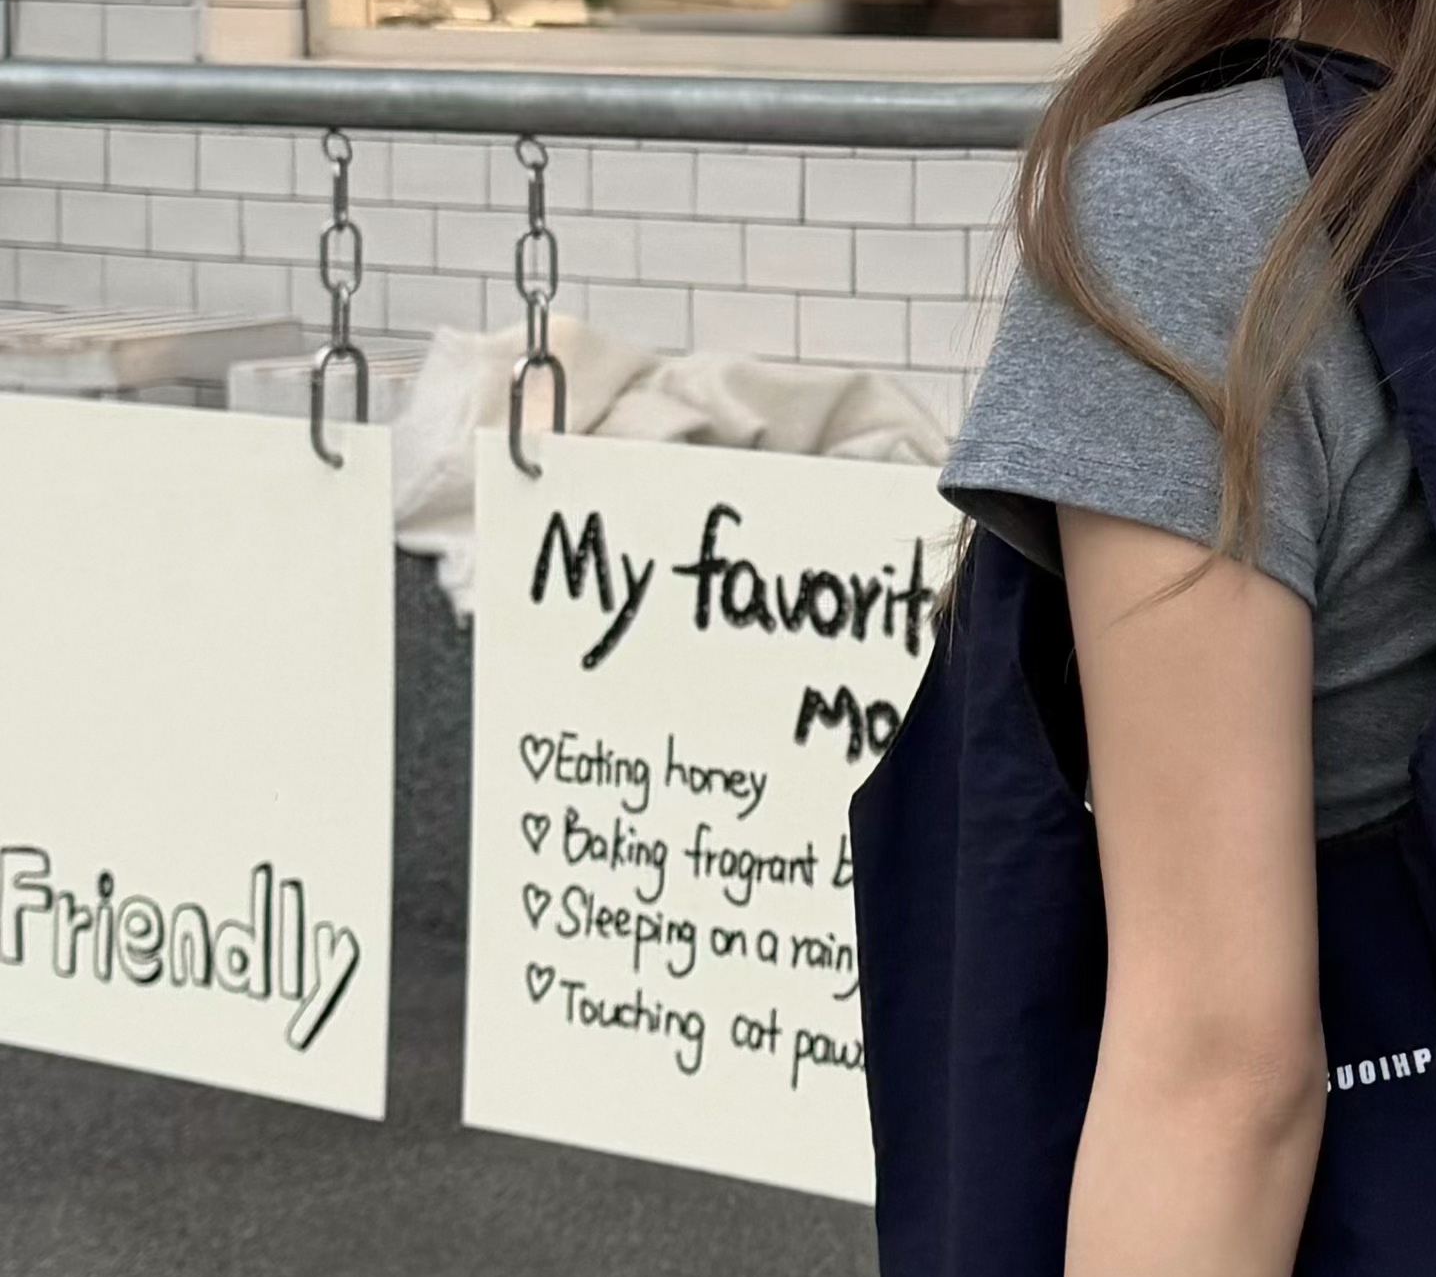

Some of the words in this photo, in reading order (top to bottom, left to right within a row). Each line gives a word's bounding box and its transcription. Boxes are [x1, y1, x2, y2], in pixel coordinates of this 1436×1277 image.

[531, 510, 656, 672] My
[671, 502, 940, 659] favorit
[554, 730, 651, 815] Eating
[663, 732, 768, 821] honey
[562, 804, 669, 904] Baking
[682, 821, 818, 907] fragrant
[0, 844, 362, 1054] Friendly
[556, 883, 697, 980] Sleeping
[710, 925, 748, 958] on
[756, 928, 780, 966] a
[559, 978, 706, 1076] Touching
[730, 1006, 783, 1056] cat
[791, 1028, 867, 1092] paw
[1326, 1047, 1432, 1093] UOIHP
